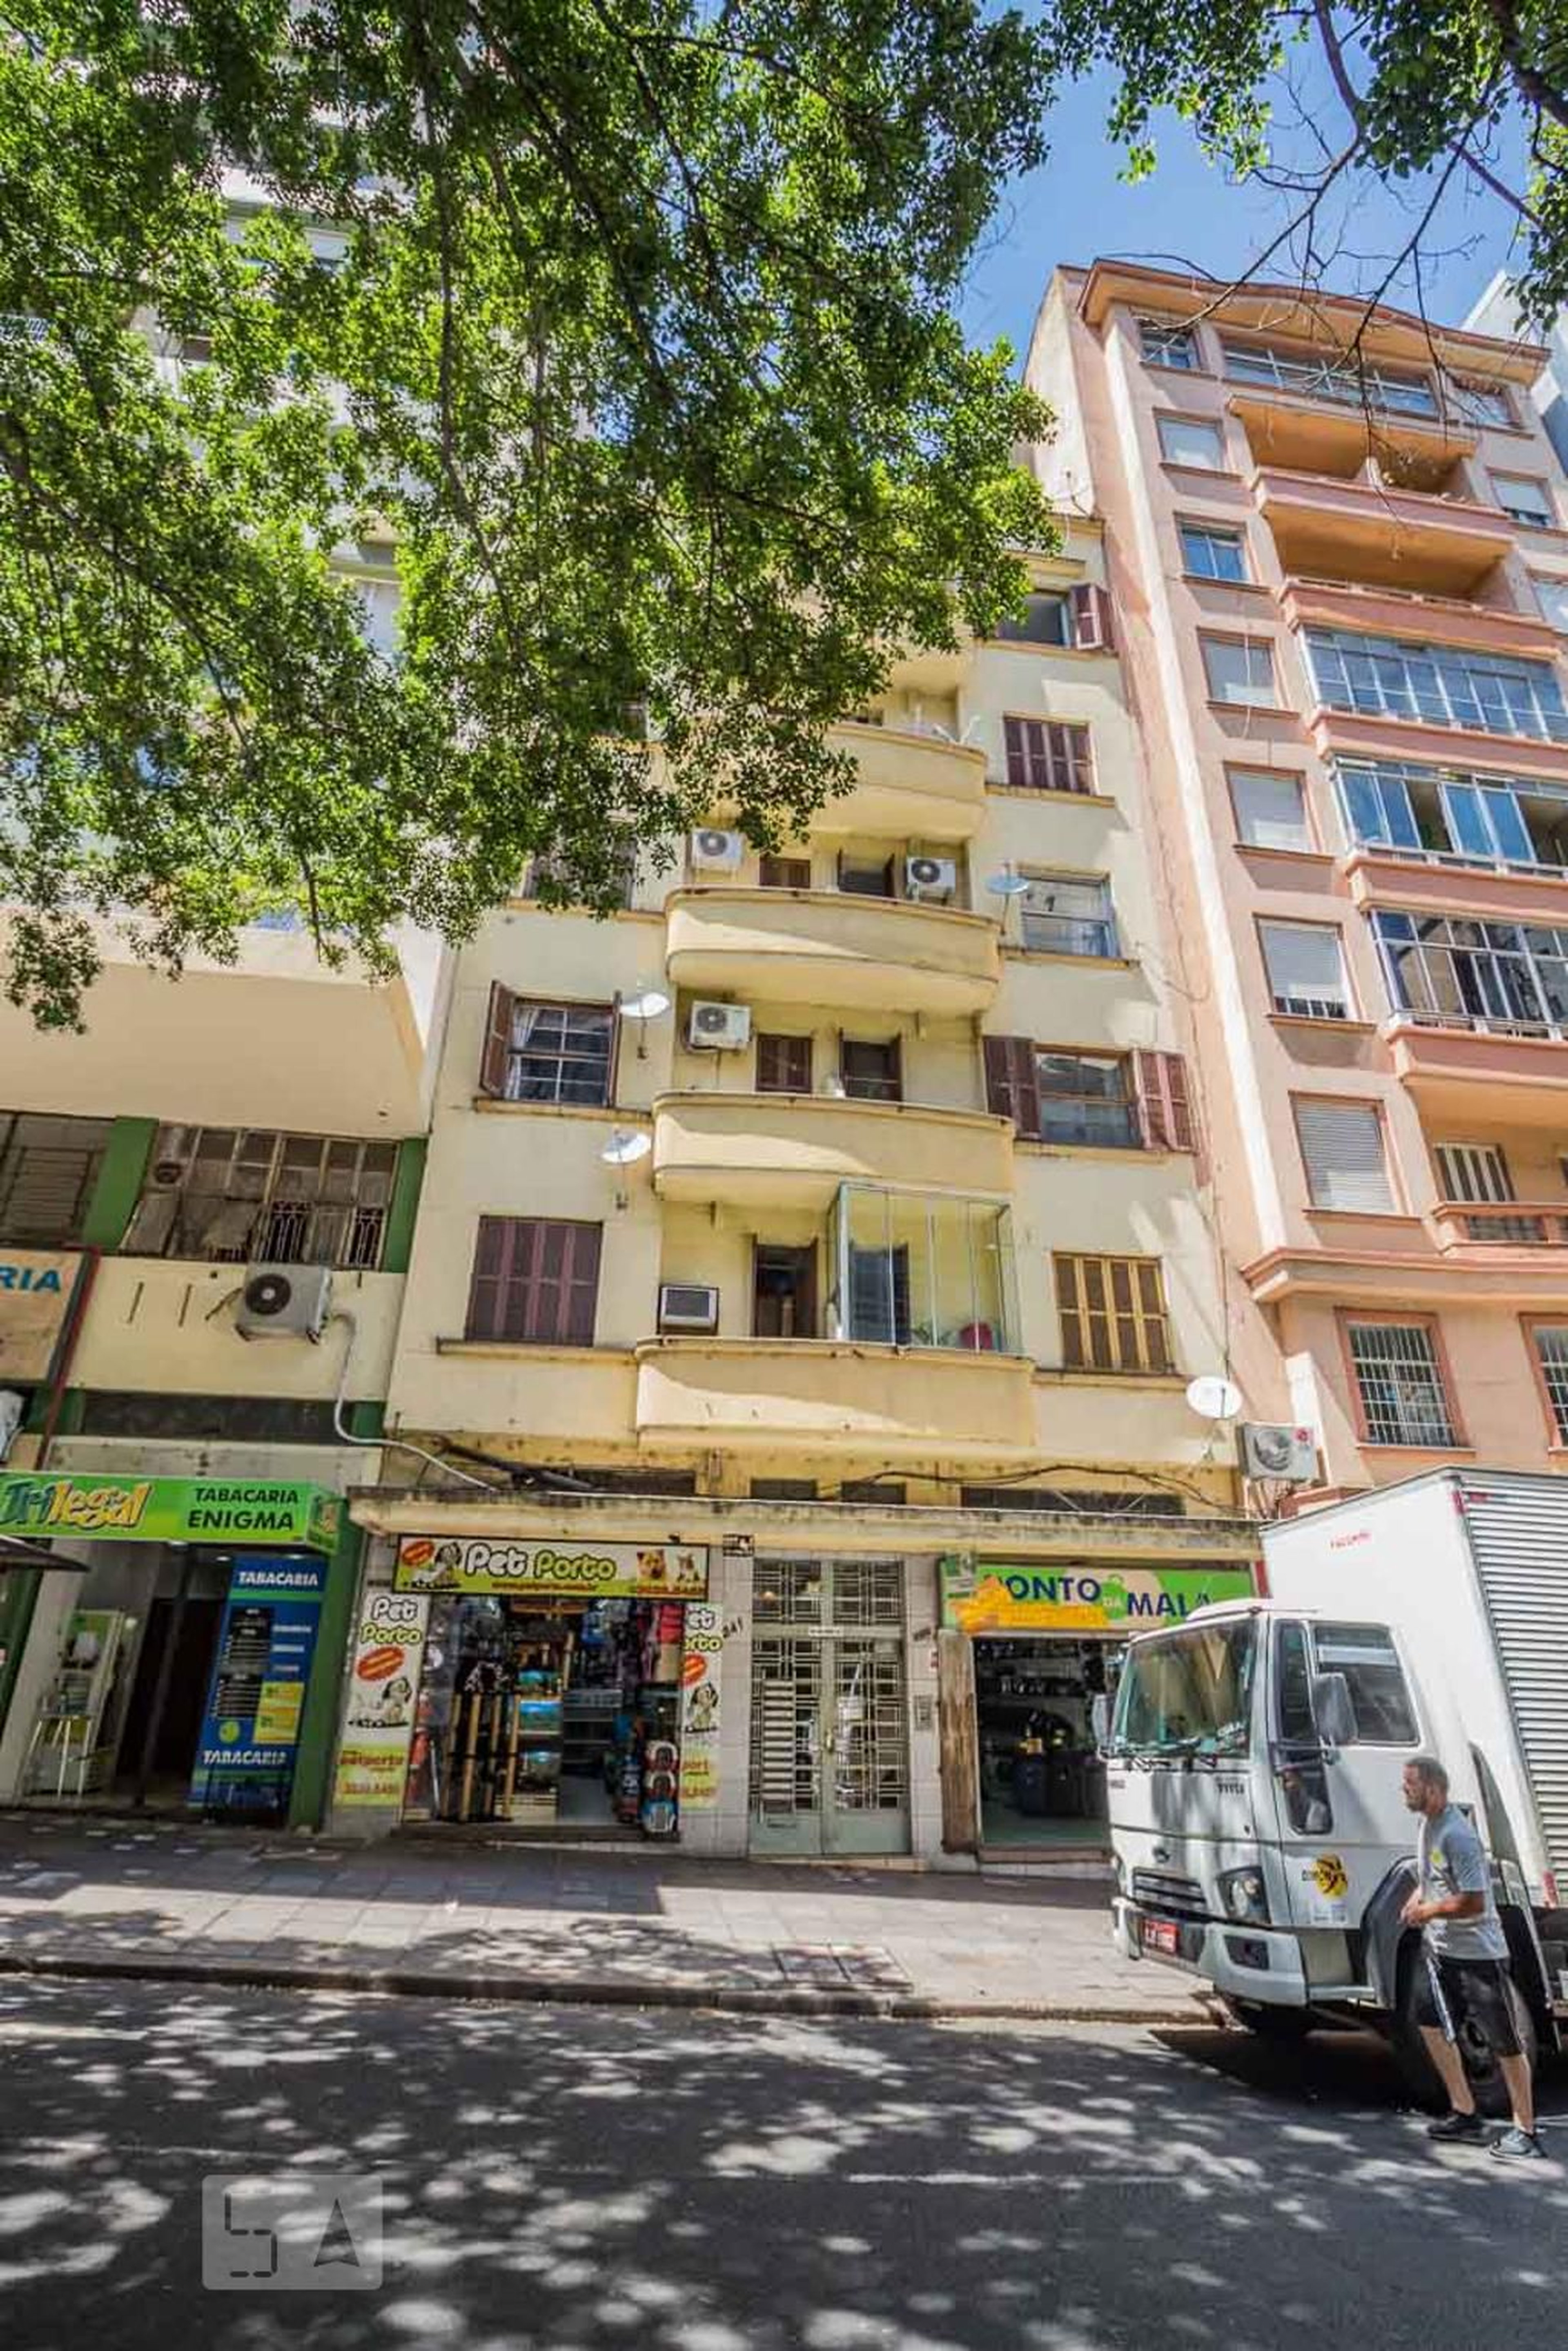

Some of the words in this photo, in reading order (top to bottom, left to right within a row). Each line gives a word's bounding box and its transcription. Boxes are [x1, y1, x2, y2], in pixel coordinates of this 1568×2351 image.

[195, 1488, 298, 1504] TABACARIA
[188, 1510, 294, 1530] ENIGMA
[465, 1543, 528, 1577] Pet
[533, 1549, 617, 1581] Porto
[238, 1571, 318, 1586] TABACARIA
[983, 1569, 1101, 1602] ONTO
[371, 1597, 418, 1622] Pet
[360, 1622, 422, 1644] Porto
[204, 1750, 287, 1765] TABACARIA
